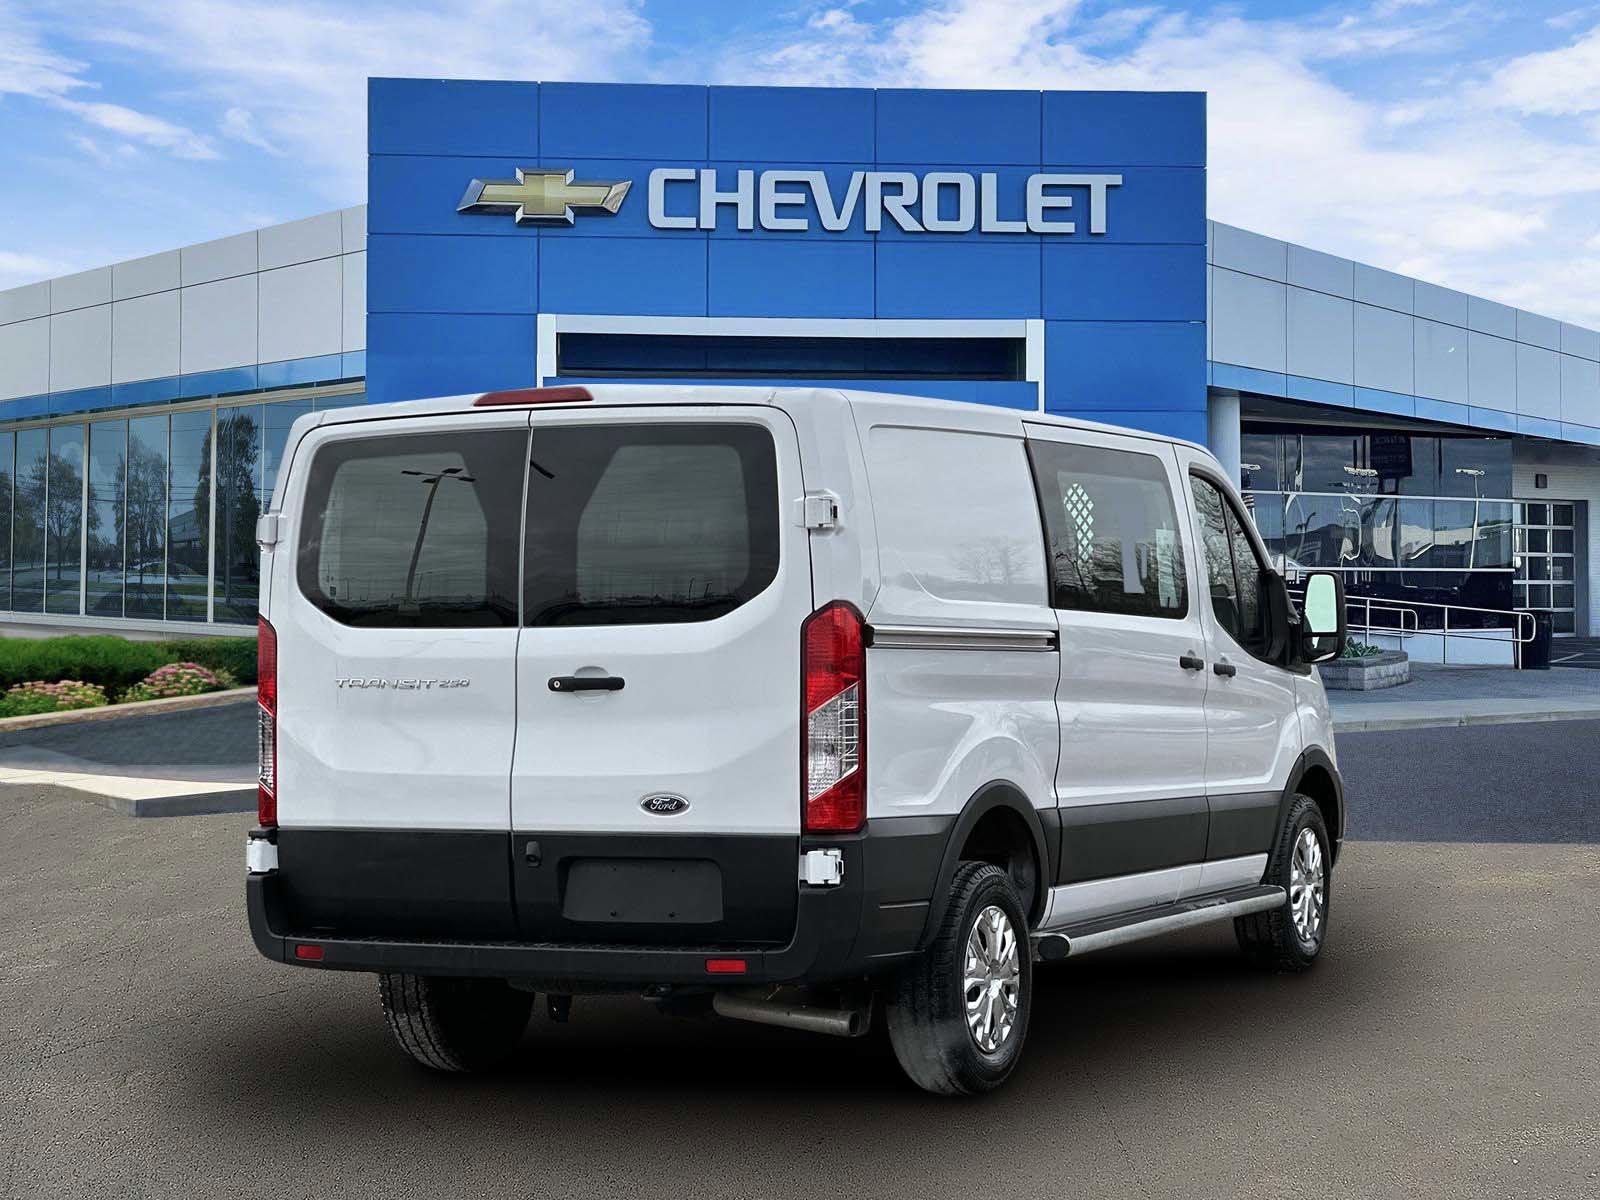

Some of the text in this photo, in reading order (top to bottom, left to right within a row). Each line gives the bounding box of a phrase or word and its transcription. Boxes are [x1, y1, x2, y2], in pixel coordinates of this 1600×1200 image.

[647, 167, 1123, 235] CHEVROLET
[335, 677, 471, 690] TRANSIT 250
[650, 797, 678, 810] Ford
